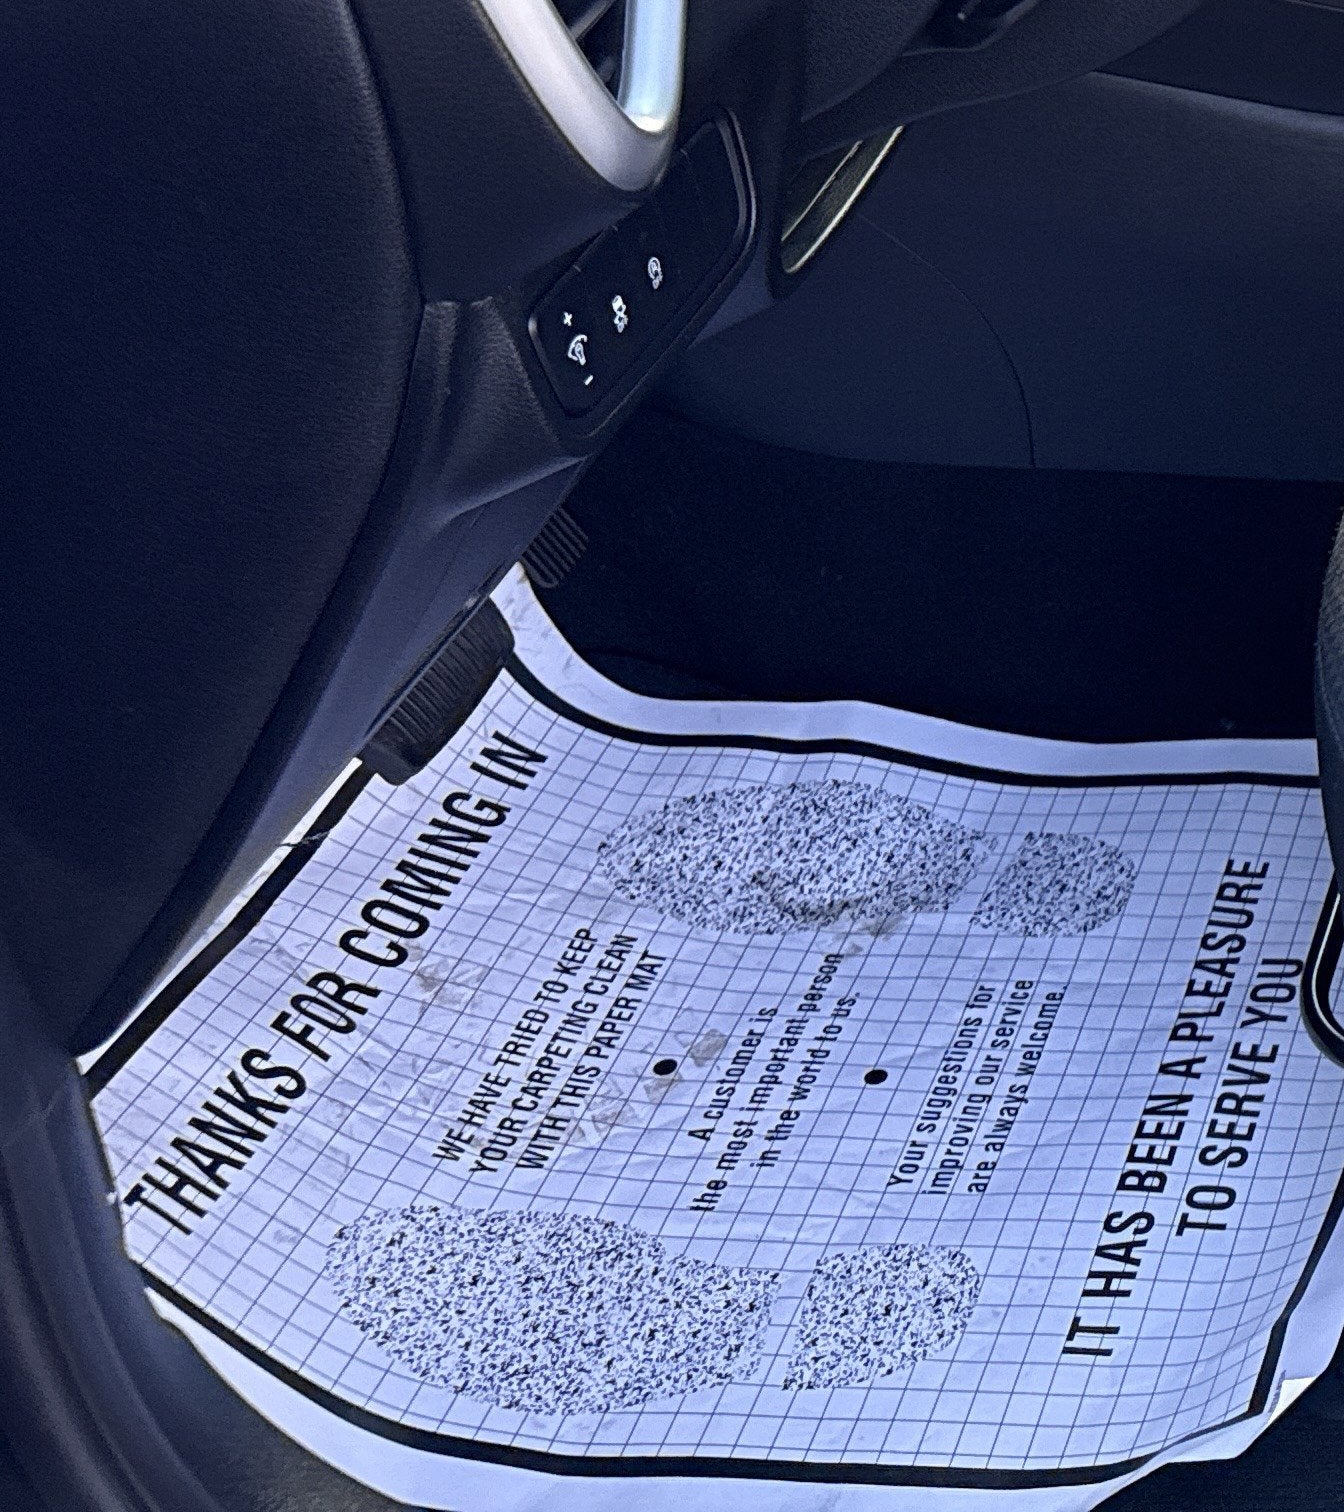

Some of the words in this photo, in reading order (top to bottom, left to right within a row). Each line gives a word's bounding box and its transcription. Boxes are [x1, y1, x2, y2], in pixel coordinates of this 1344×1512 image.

[124, 1046, 306, 1236] THANKS
[270, 968, 380, 1061] FOR
[339, 788, 513, 969] COMING
[471, 731, 548, 791] IN
[831, 990, 860, 1017] us.
[1171, 858, 1271, 1052] PLEASURE
[1242, 958, 1304, 1033] YOU
[432, 1129, 474, 1161] WE
[458, 1073, 511, 1128] HAVE
[493, 1009, 549, 1066] TRIED
[534, 981, 568, 1002] TO
[554, 929, 597, 976] KEEP
[469, 1117, 528, 1173] YOUR
[512, 998, 598, 1111] CARPETING
[583, 931, 638, 995] CLEAN
[515, 1114, 570, 1168] WITH
[551, 1062, 601, 1108] THIS
[583, 991, 642, 1059] PAPER
[623, 947, 666, 990] MAT
[688, 1128, 715, 1142] A
[704, 1030, 765, 1119] customer
[749, 1008, 778, 1023] is
[690, 1180, 727, 1212] the
[716, 1121, 758, 1170] most
[743, 1016, 809, 1113] important
[797, 953, 844, 1013] person
[788, 1048, 830, 1102] world
[814, 1024, 842, 1042] to
[886, 1141, 927, 1186] Your
[917, 1017, 982, 1133] suggestions
[965, 982, 995, 1009] for
[921, 1094, 993, 1194] improving
[975, 1055, 1002, 1085] our
[991, 981, 1033, 1048] service
[1159, 1055, 1207, 1083] A
[765, 1108, 800, 1141] the
[968, 1160, 998, 1195] are
[984, 1084, 1029, 1153] always
[1015, 986, 1067, 1077] welcome.
[1116, 1091, 1190, 1194] BEEN
[1202, 1043, 1279, 1169] SERVE
[750, 1149, 781, 1168] in
[1177, 1185, 1237, 1237] TO
[1082, 1210, 1156, 1299] HAS
[1062, 1315, 1121, 1357] IT
